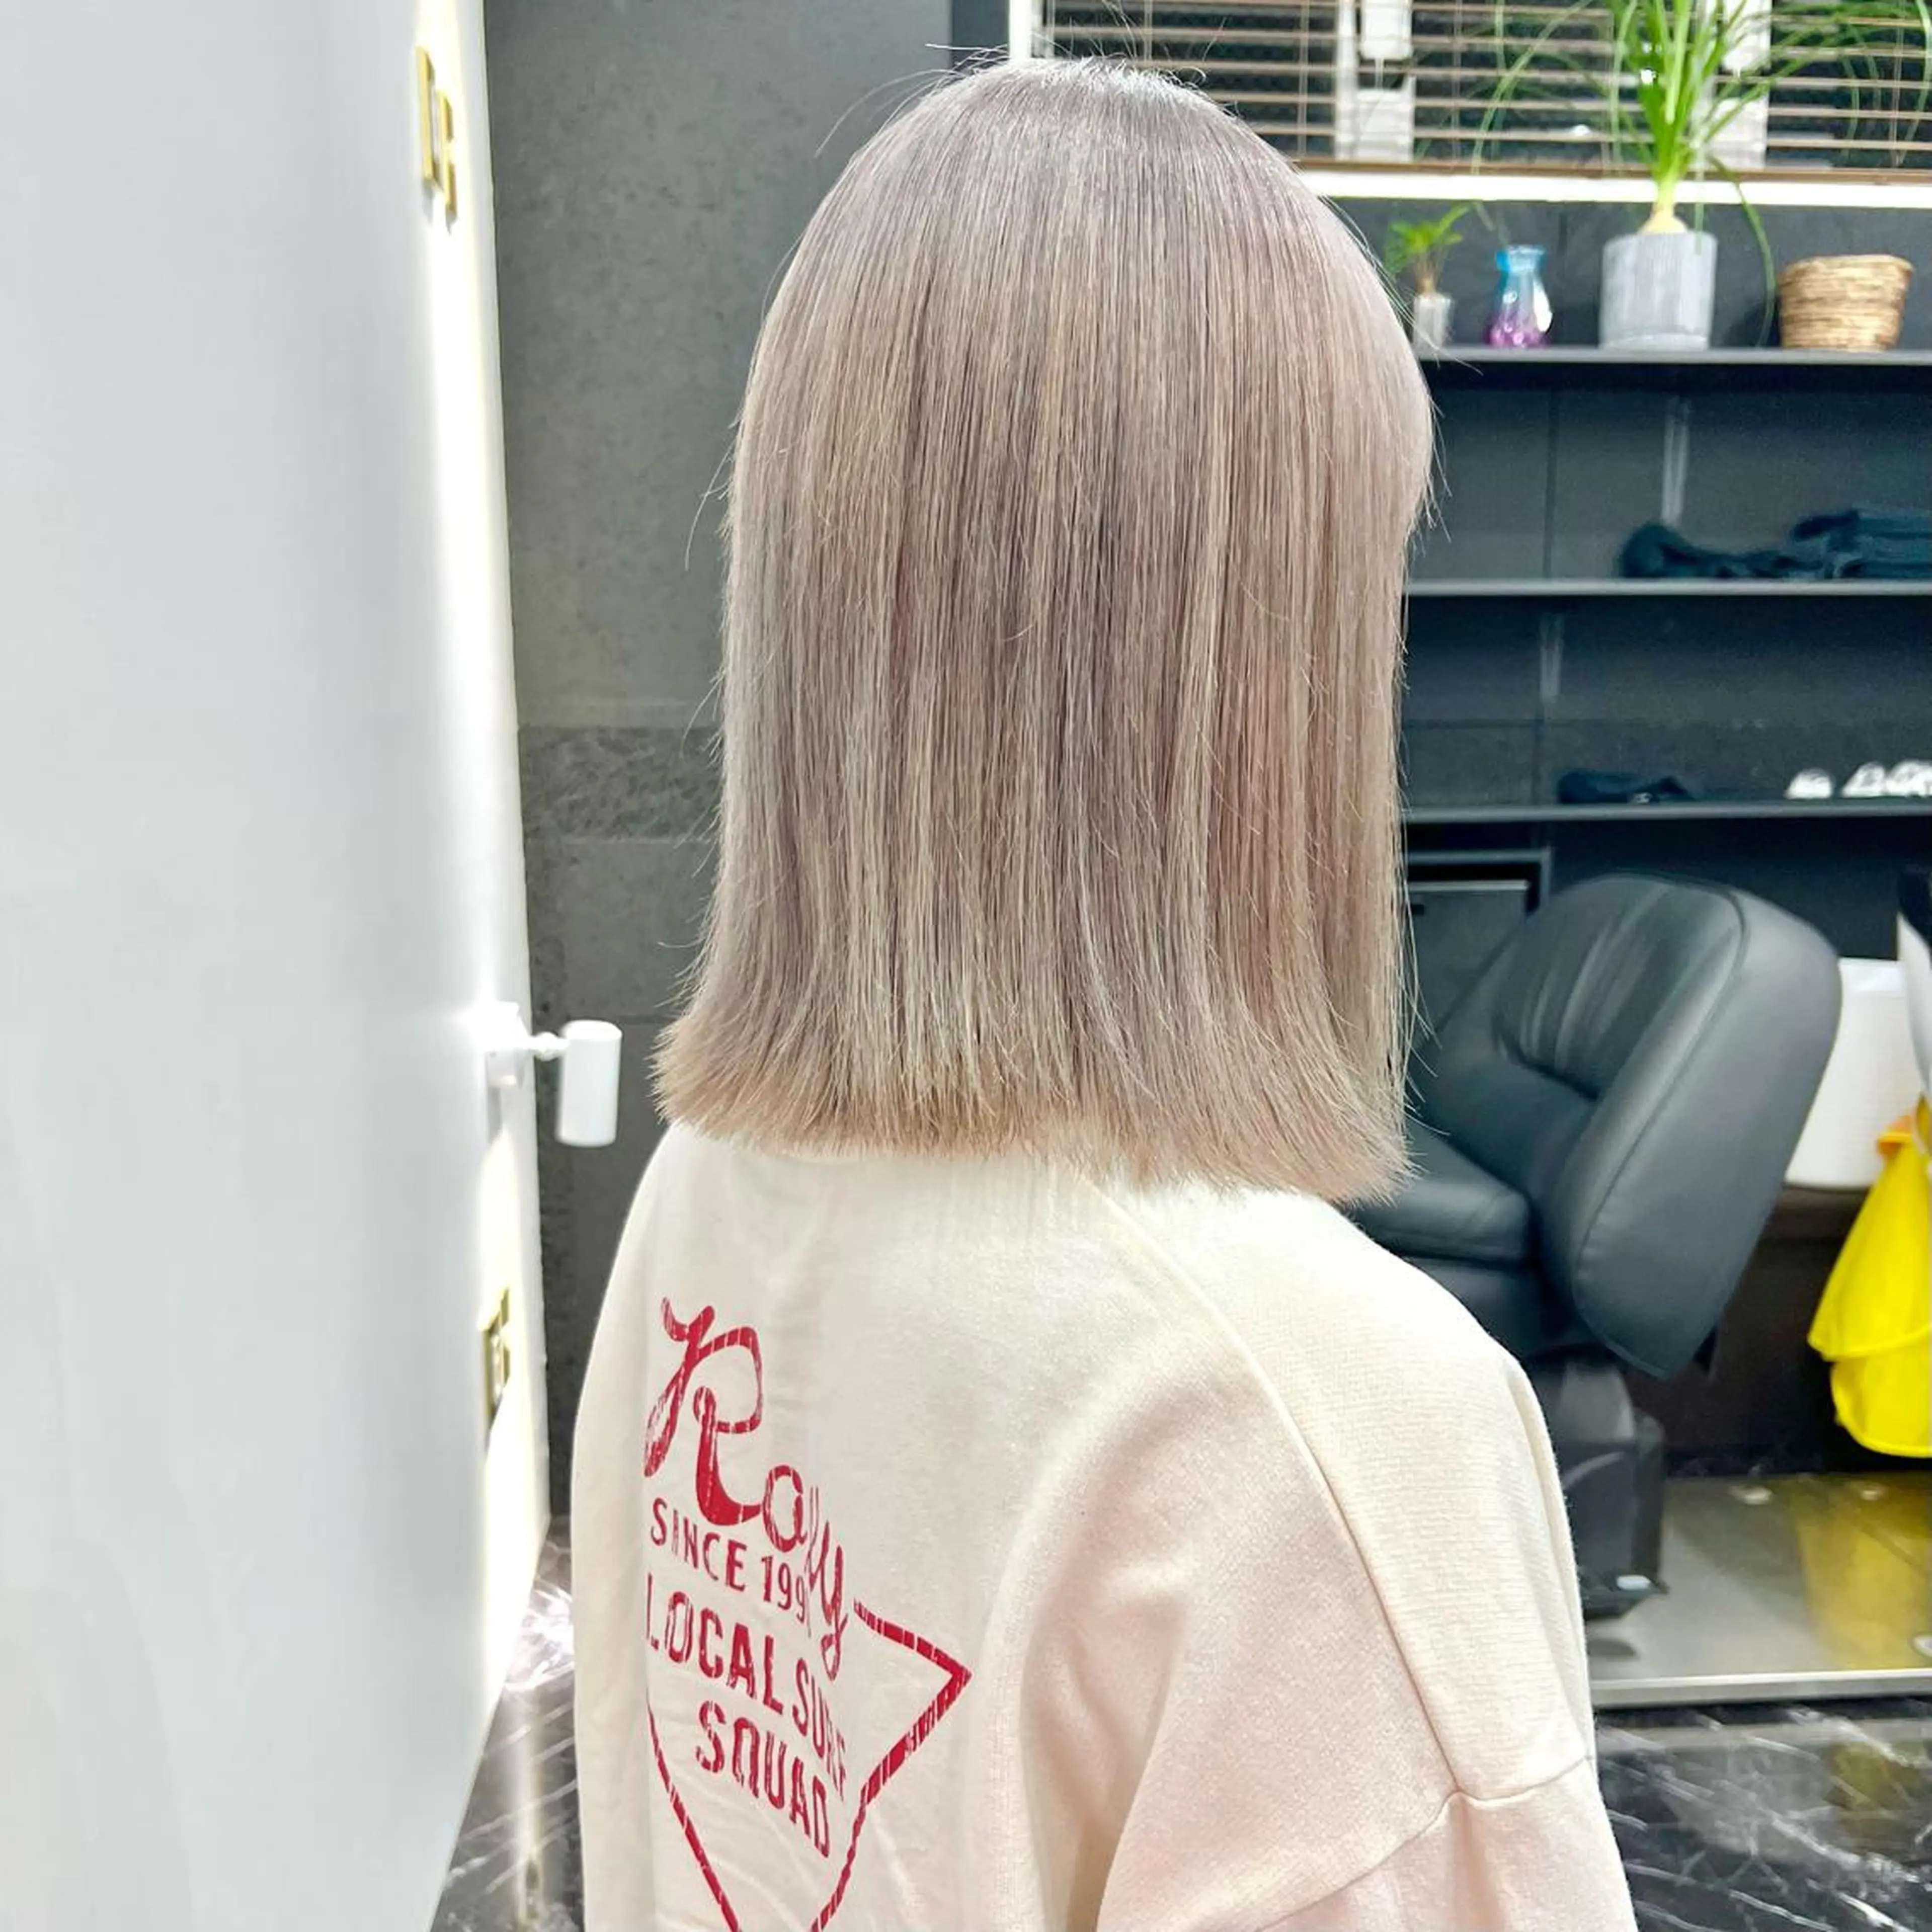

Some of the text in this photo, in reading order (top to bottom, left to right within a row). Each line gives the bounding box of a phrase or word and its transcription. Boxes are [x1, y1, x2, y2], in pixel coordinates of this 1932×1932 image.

[651, 1497, 812, 1638] SINCE 199
[646, 1572, 784, 1716] LOCAL
[695, 1700, 831, 1859] SQUAD
